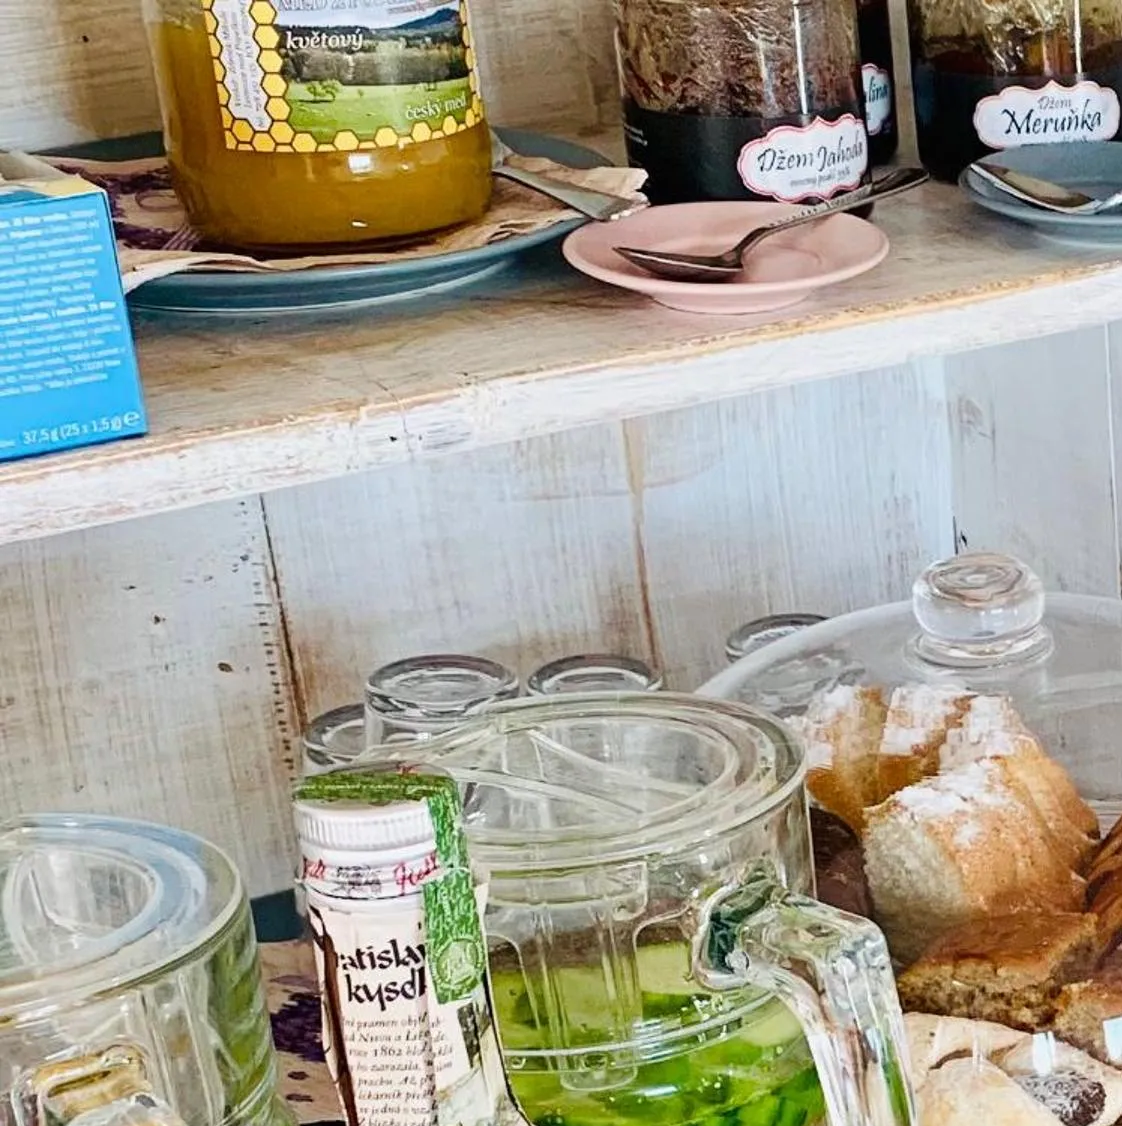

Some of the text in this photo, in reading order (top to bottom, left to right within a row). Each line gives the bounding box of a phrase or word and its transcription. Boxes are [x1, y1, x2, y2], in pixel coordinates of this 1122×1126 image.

[286, 28, 364, 51] květový
[404, 93, 467, 120] český med
[1037, 95, 1072, 110] Džem
[1001, 98, 1101, 135] Meruňka
[757, 136, 863, 172] Džem Jahoda
